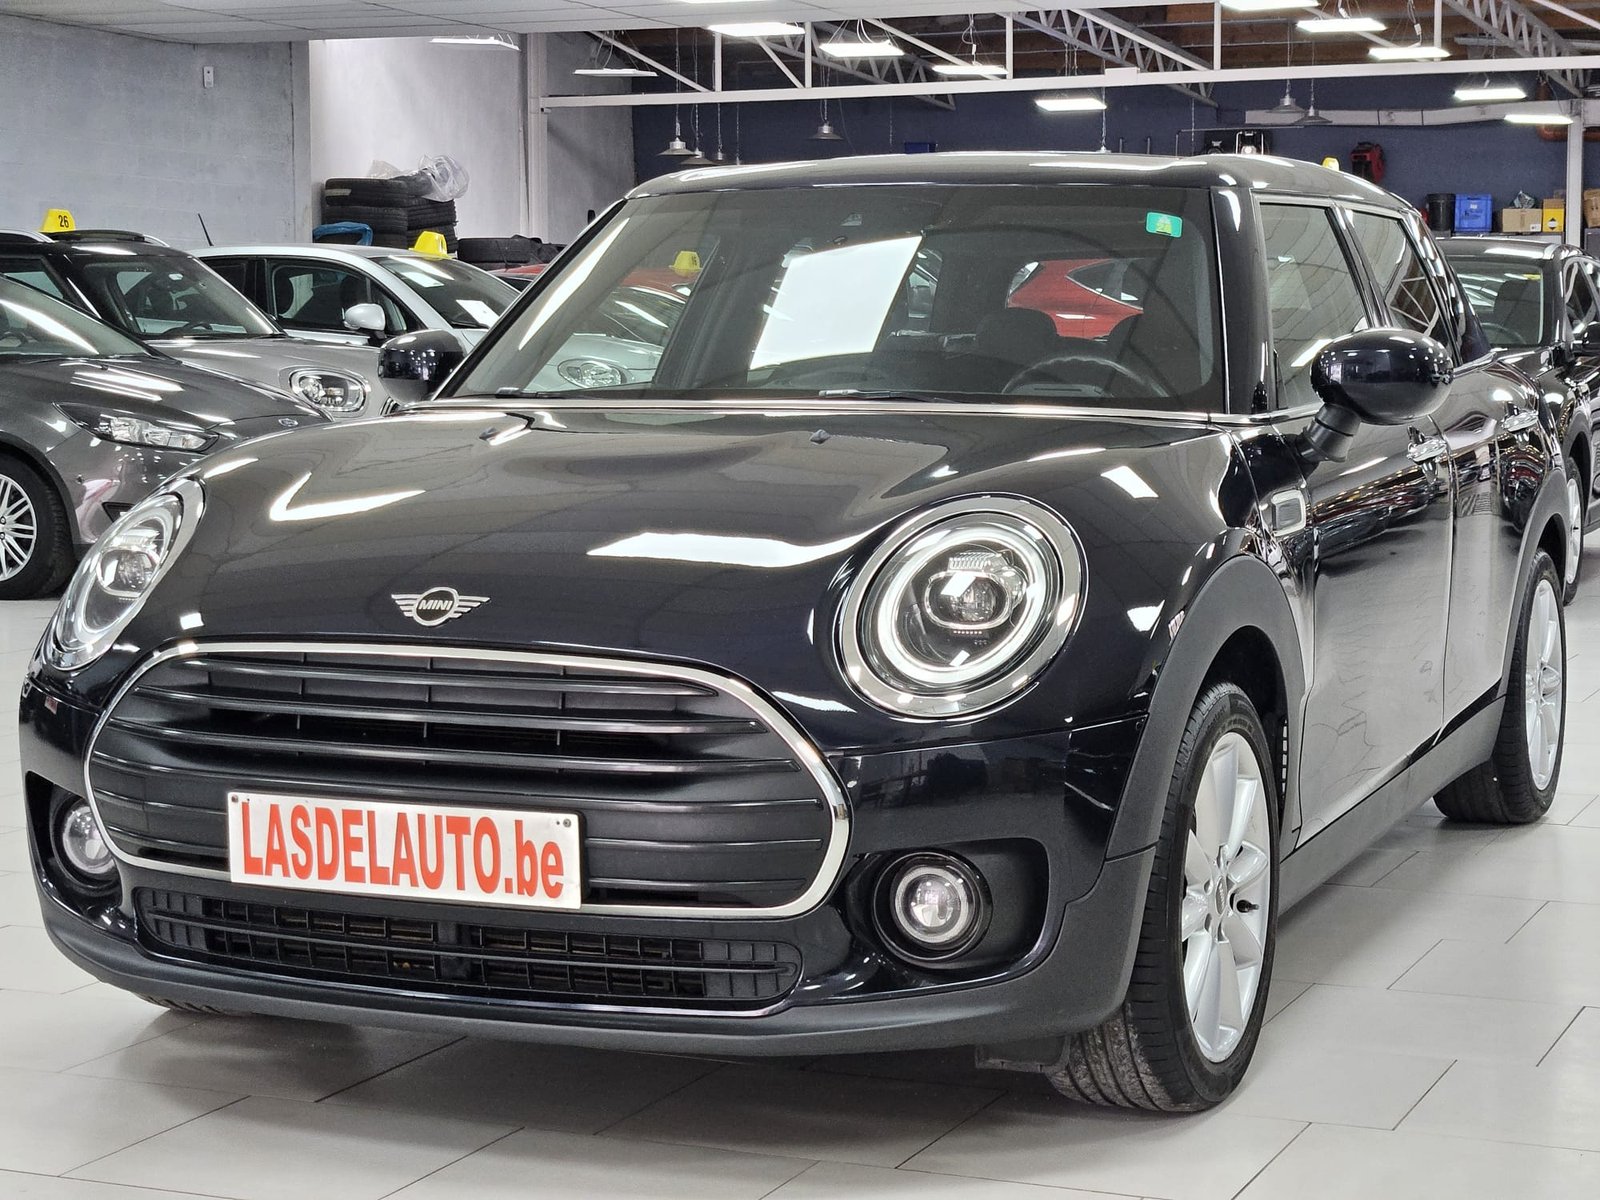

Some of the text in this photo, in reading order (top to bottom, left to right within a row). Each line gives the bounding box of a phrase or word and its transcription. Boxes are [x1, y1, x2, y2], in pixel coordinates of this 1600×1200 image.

[58, 215, 69, 228] 26
[418, 599, 453, 611] MINI
[241, 801, 564, 899] LASDELAUTO.be
